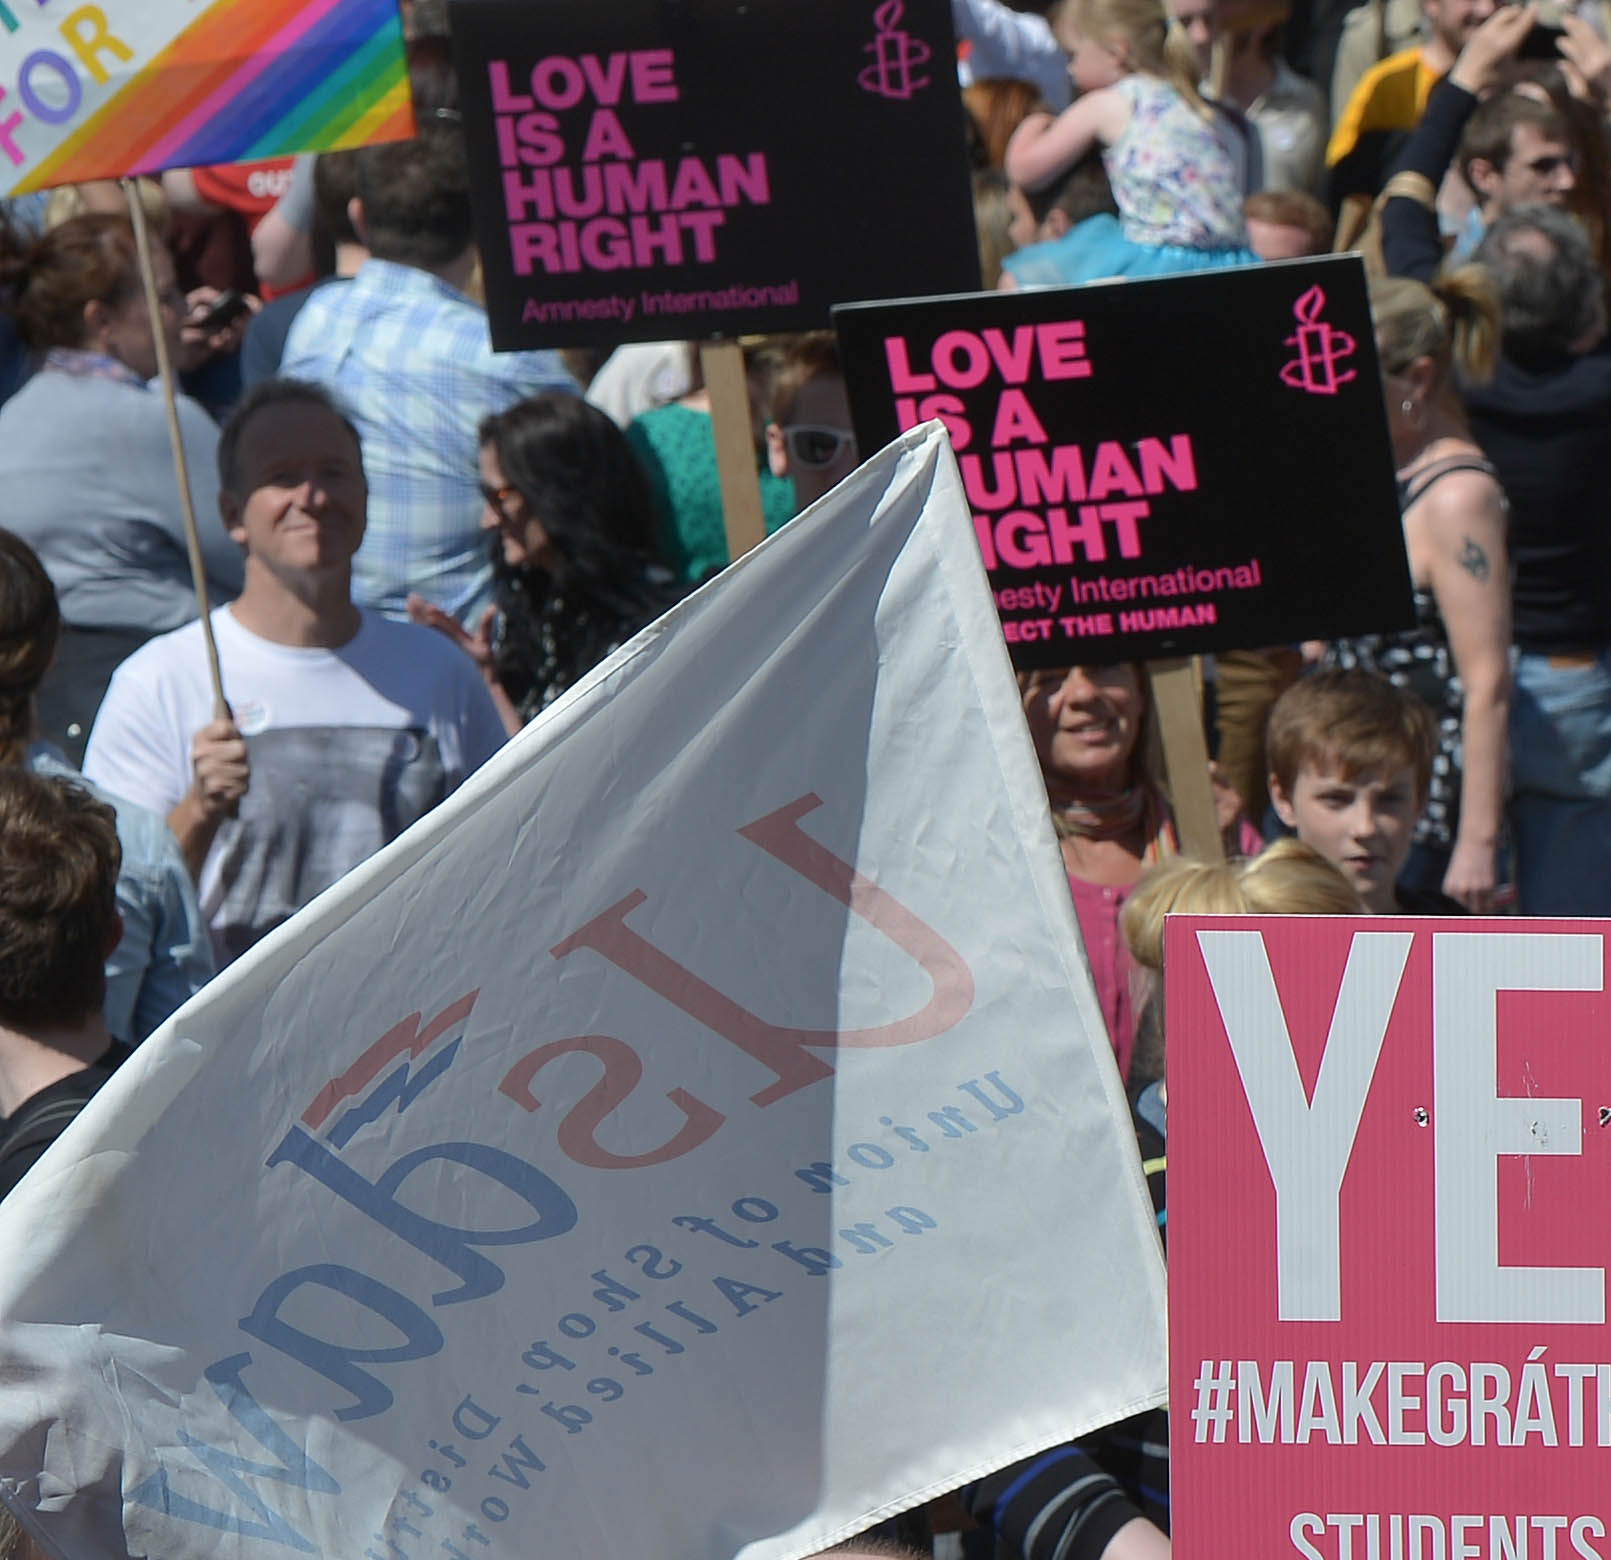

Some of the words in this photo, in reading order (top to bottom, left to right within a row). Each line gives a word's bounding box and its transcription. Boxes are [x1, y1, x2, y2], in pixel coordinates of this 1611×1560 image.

[488, 48, 680, 114] LOVE
[497, 112, 565, 167] IS
[582, 108, 635, 162] A
[503, 152, 771, 222] HUMAN
[510, 209, 726, 275] RIGHT
[523, 296, 636, 322] Amnesty
[641, 280, 799, 314] International
[884, 320, 1094, 394] LOVE
[991, 388, 1048, 448] A
[961, 434, 1198, 511] UMAN
[973, 500, 1150, 571] IGHT
[1071, 559, 1263, 603] International
[1060, 613, 1114, 637] THE
[1119, 604, 1217, 632] HUMAN
